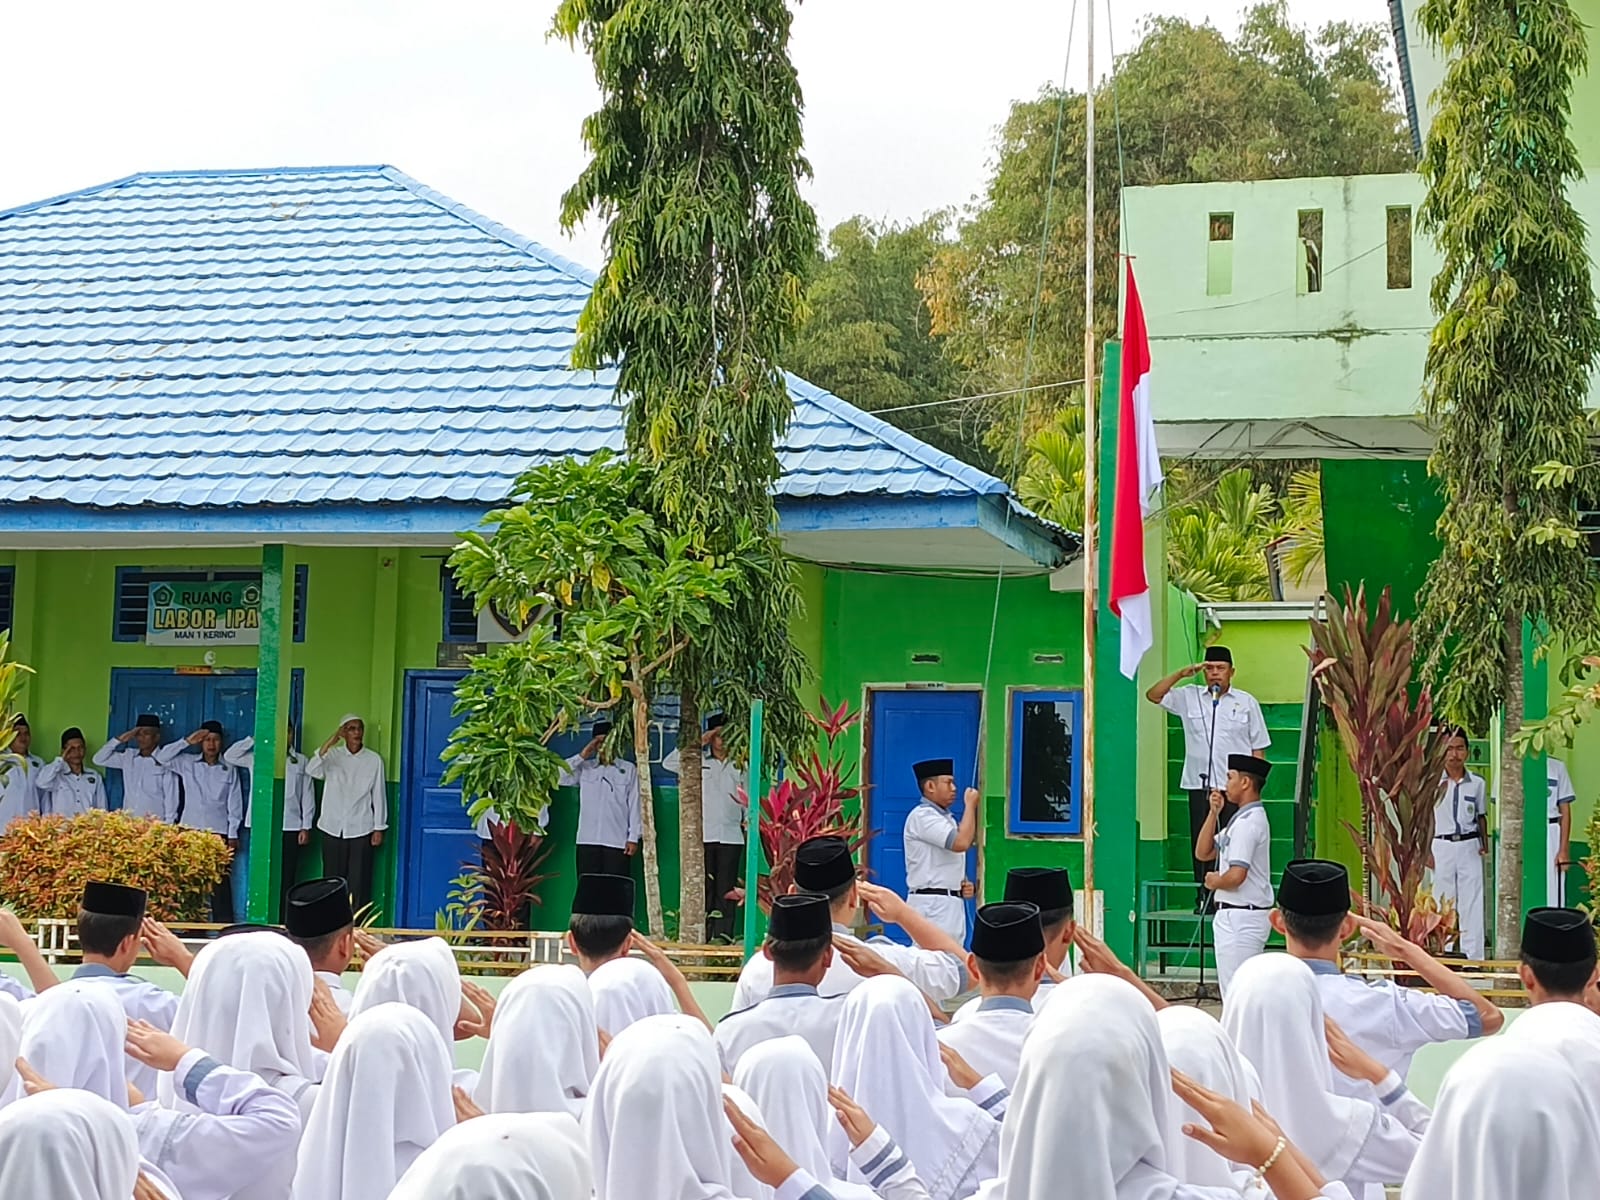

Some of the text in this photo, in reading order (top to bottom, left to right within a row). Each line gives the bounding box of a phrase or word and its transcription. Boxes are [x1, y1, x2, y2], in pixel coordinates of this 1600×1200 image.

[182, 591, 232, 605] RUANG
[154, 608, 258, 629] LABOR IPA
[174, 630, 236, 639] MAN 1 KERINCI
